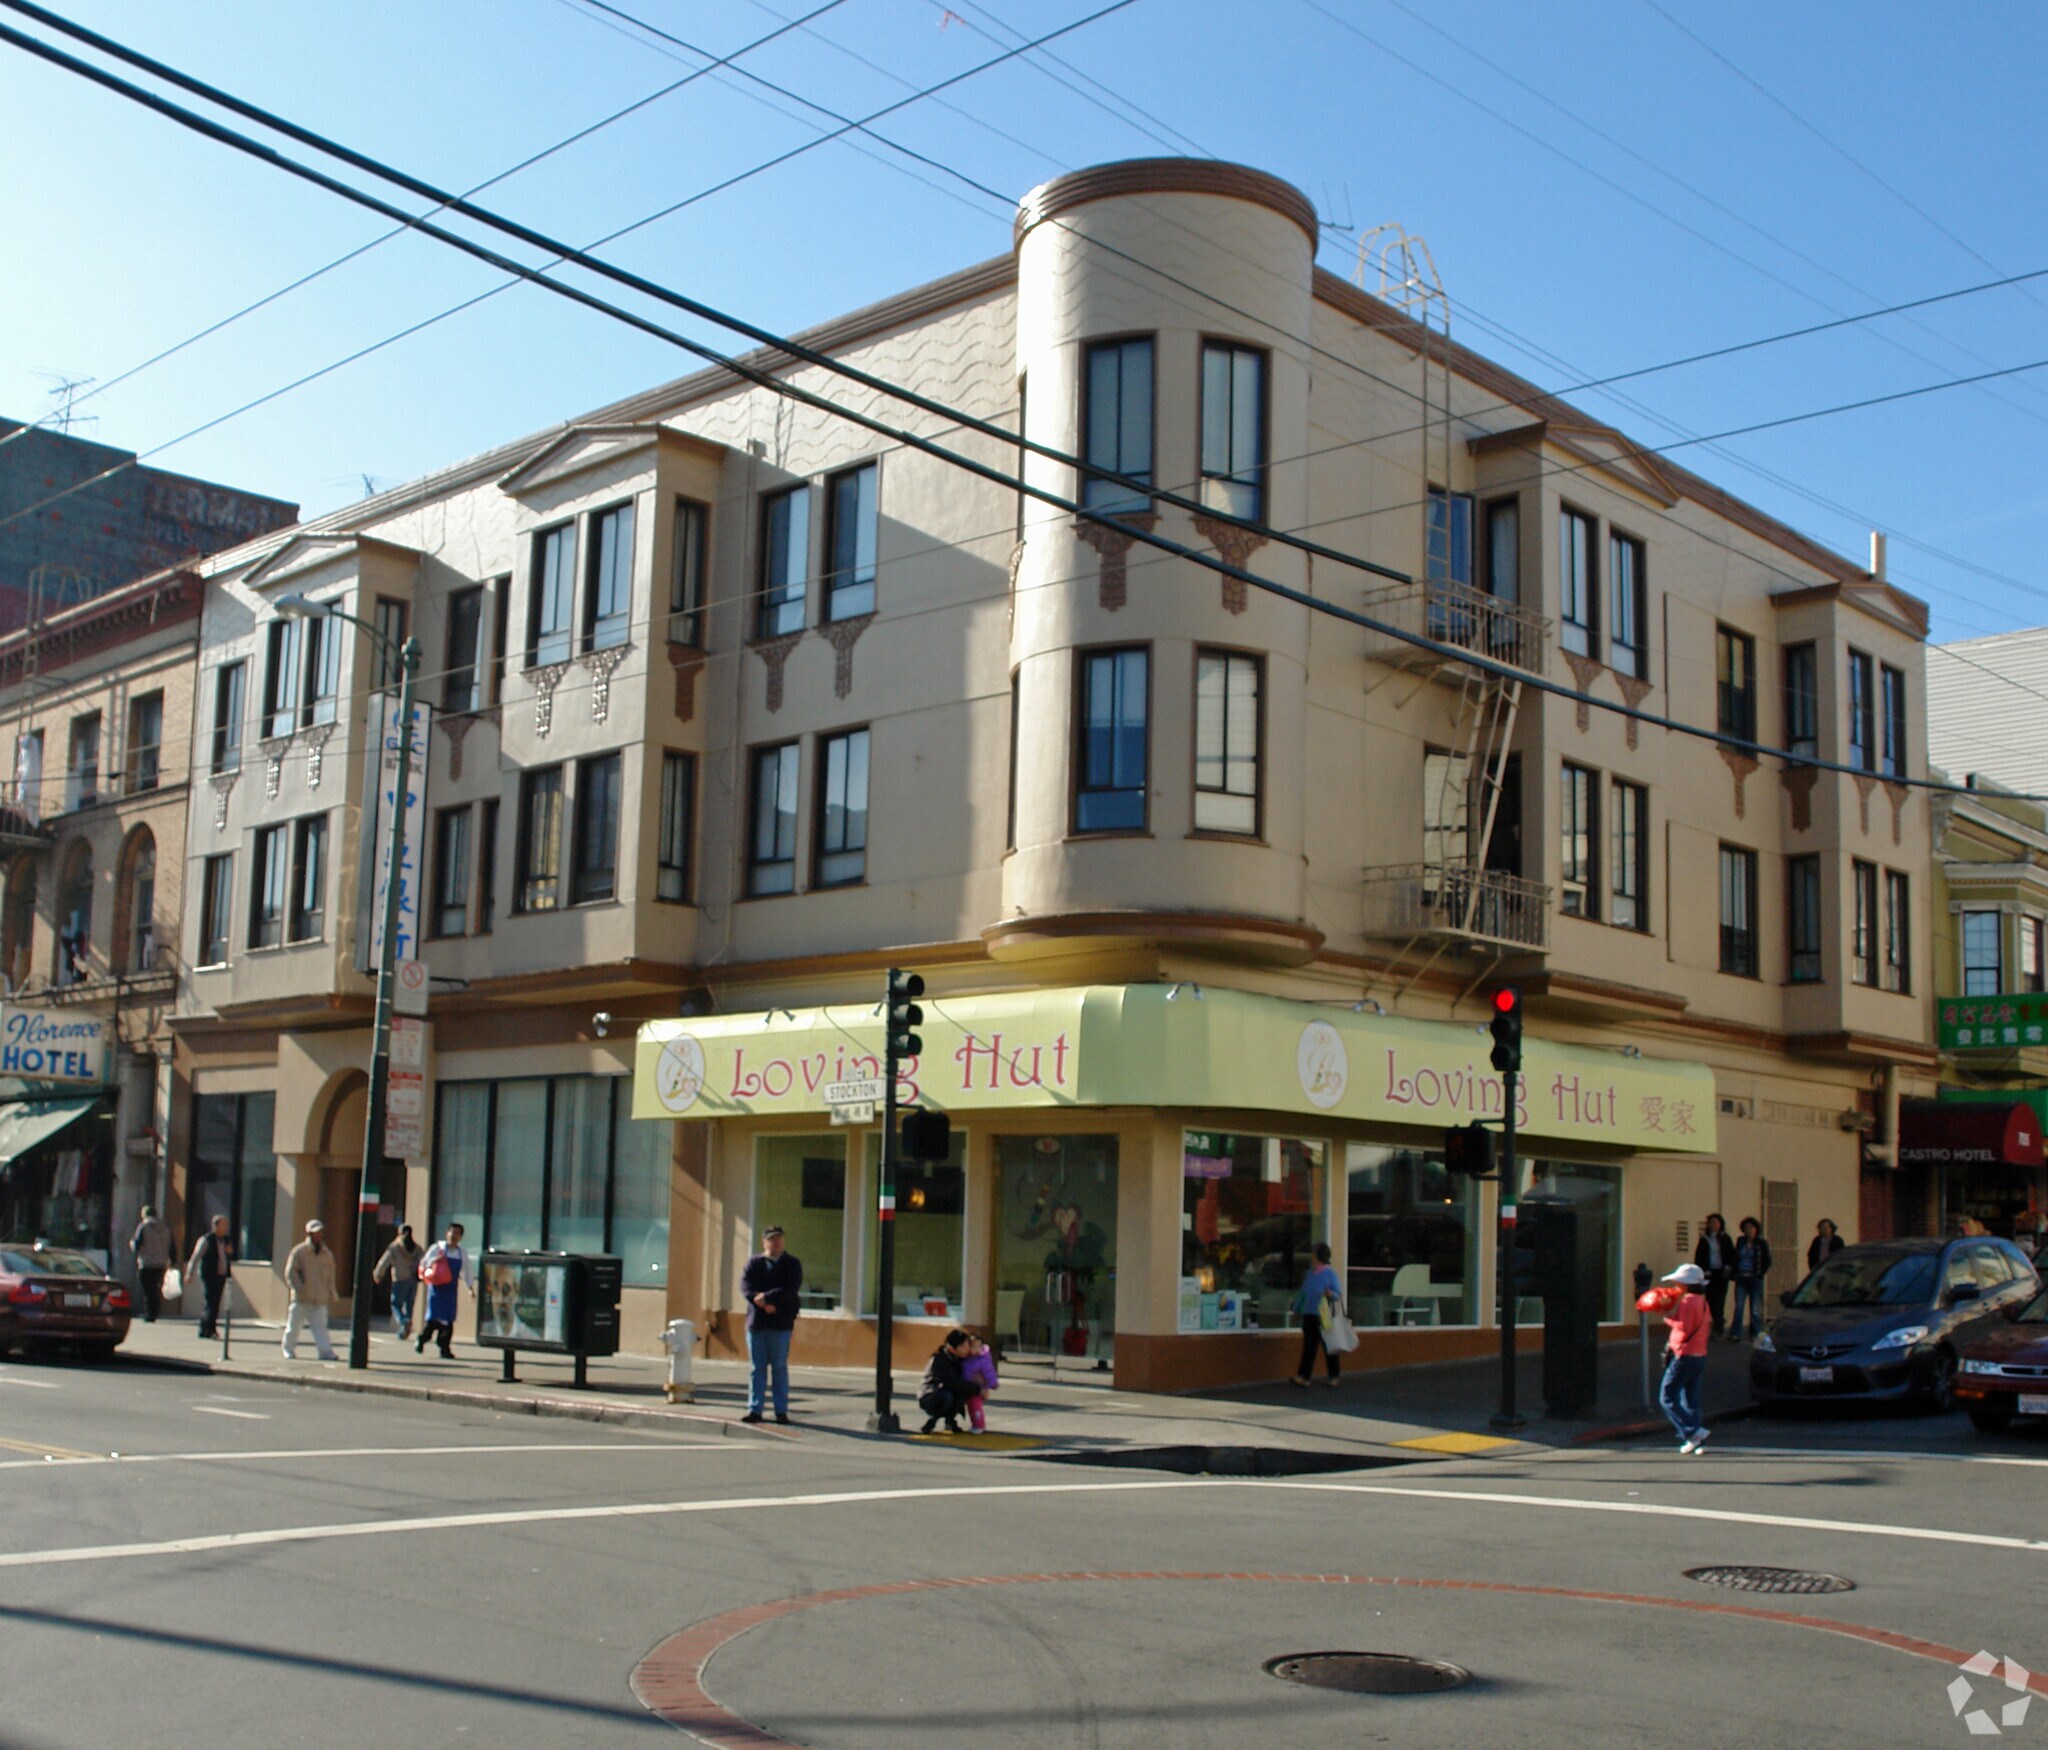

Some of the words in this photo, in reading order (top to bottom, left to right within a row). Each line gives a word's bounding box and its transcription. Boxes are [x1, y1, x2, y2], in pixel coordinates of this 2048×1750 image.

[7, 1013, 101, 1045] Florence
[2, 1045, 93, 1077] HOTEL
[730, 1046, 920, 1105] Loving
[955, 1033, 1069, 1088] Hut
[830, 1083, 877, 1100] STOCKTON
[1385, 1050, 1528, 1127] Loving
[1552, 1074, 1616, 1127] Hut
[1640, 1096, 1696, 1135] 愛家
[1900, 1149, 1950, 1160] CASTRO
[1953, 1149, 1996, 1161] HOTEL
